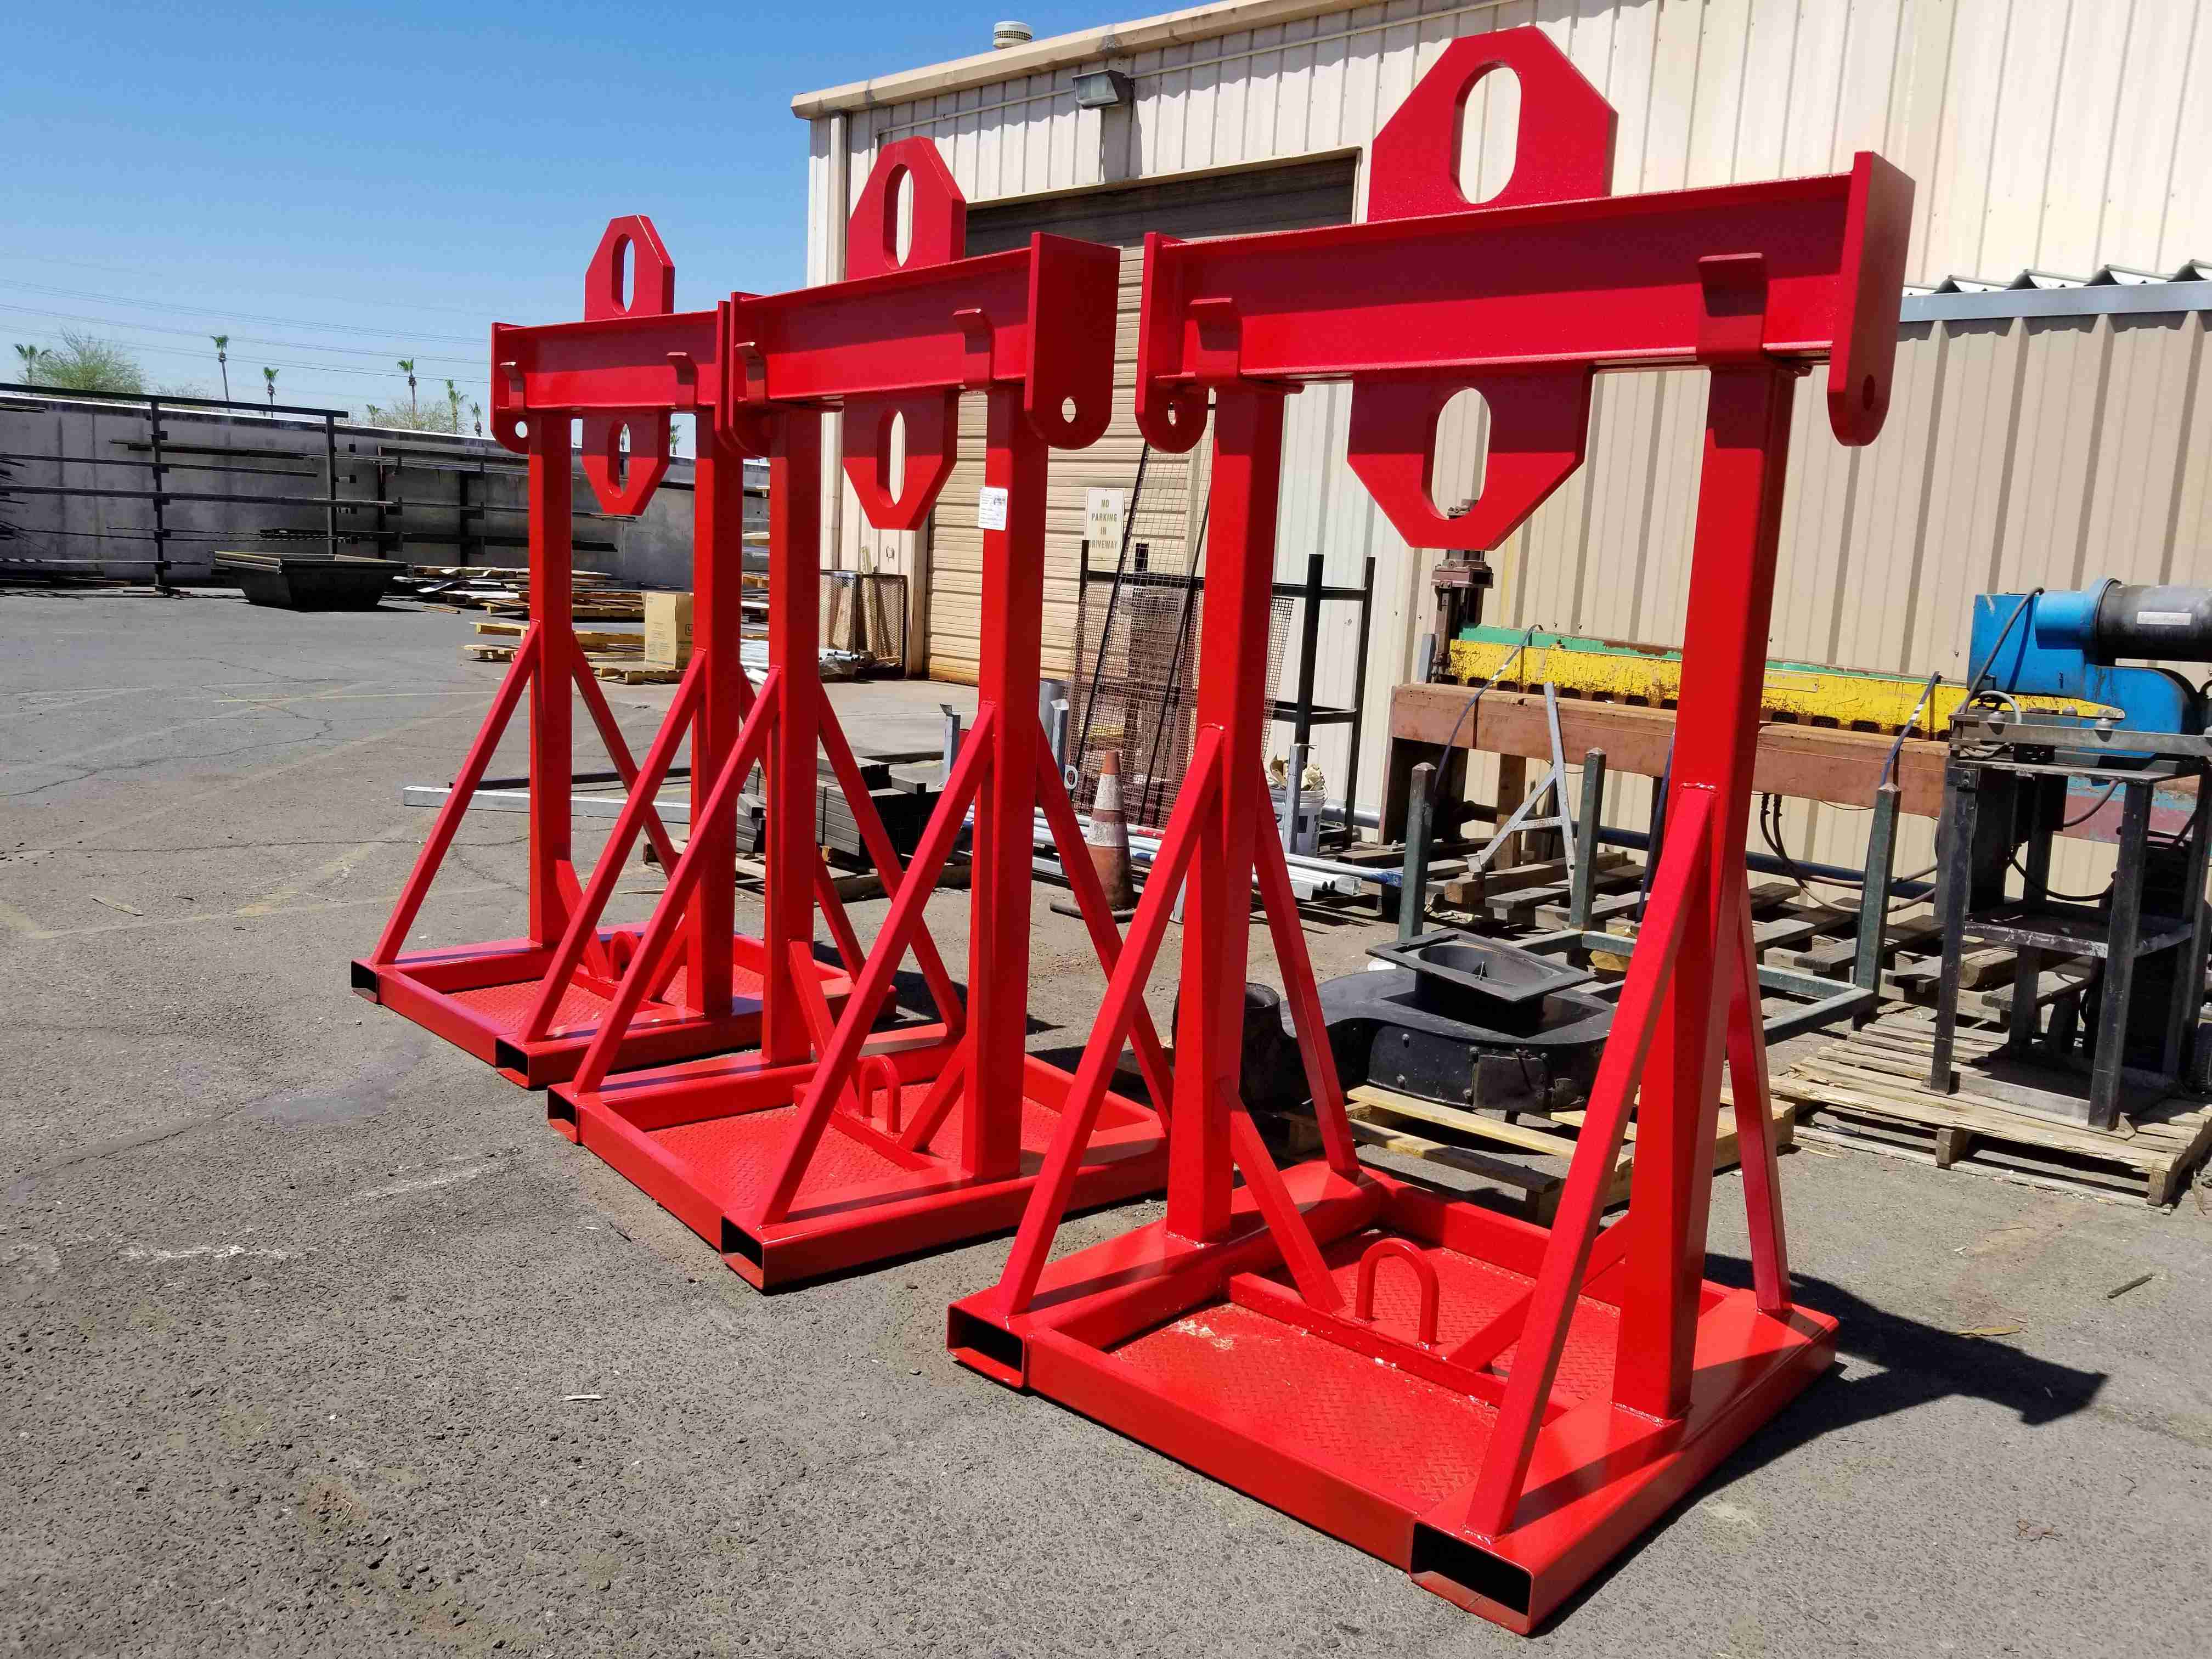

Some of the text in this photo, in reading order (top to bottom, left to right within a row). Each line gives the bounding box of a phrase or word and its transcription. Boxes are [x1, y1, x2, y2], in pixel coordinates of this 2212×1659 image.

[1101, 499, 1109, 507] NO
[1092, 513, 1117, 522] PARKING
[1101, 527, 1107, 535] IN
[1088, 540, 1118, 549] DRIVEWAY
